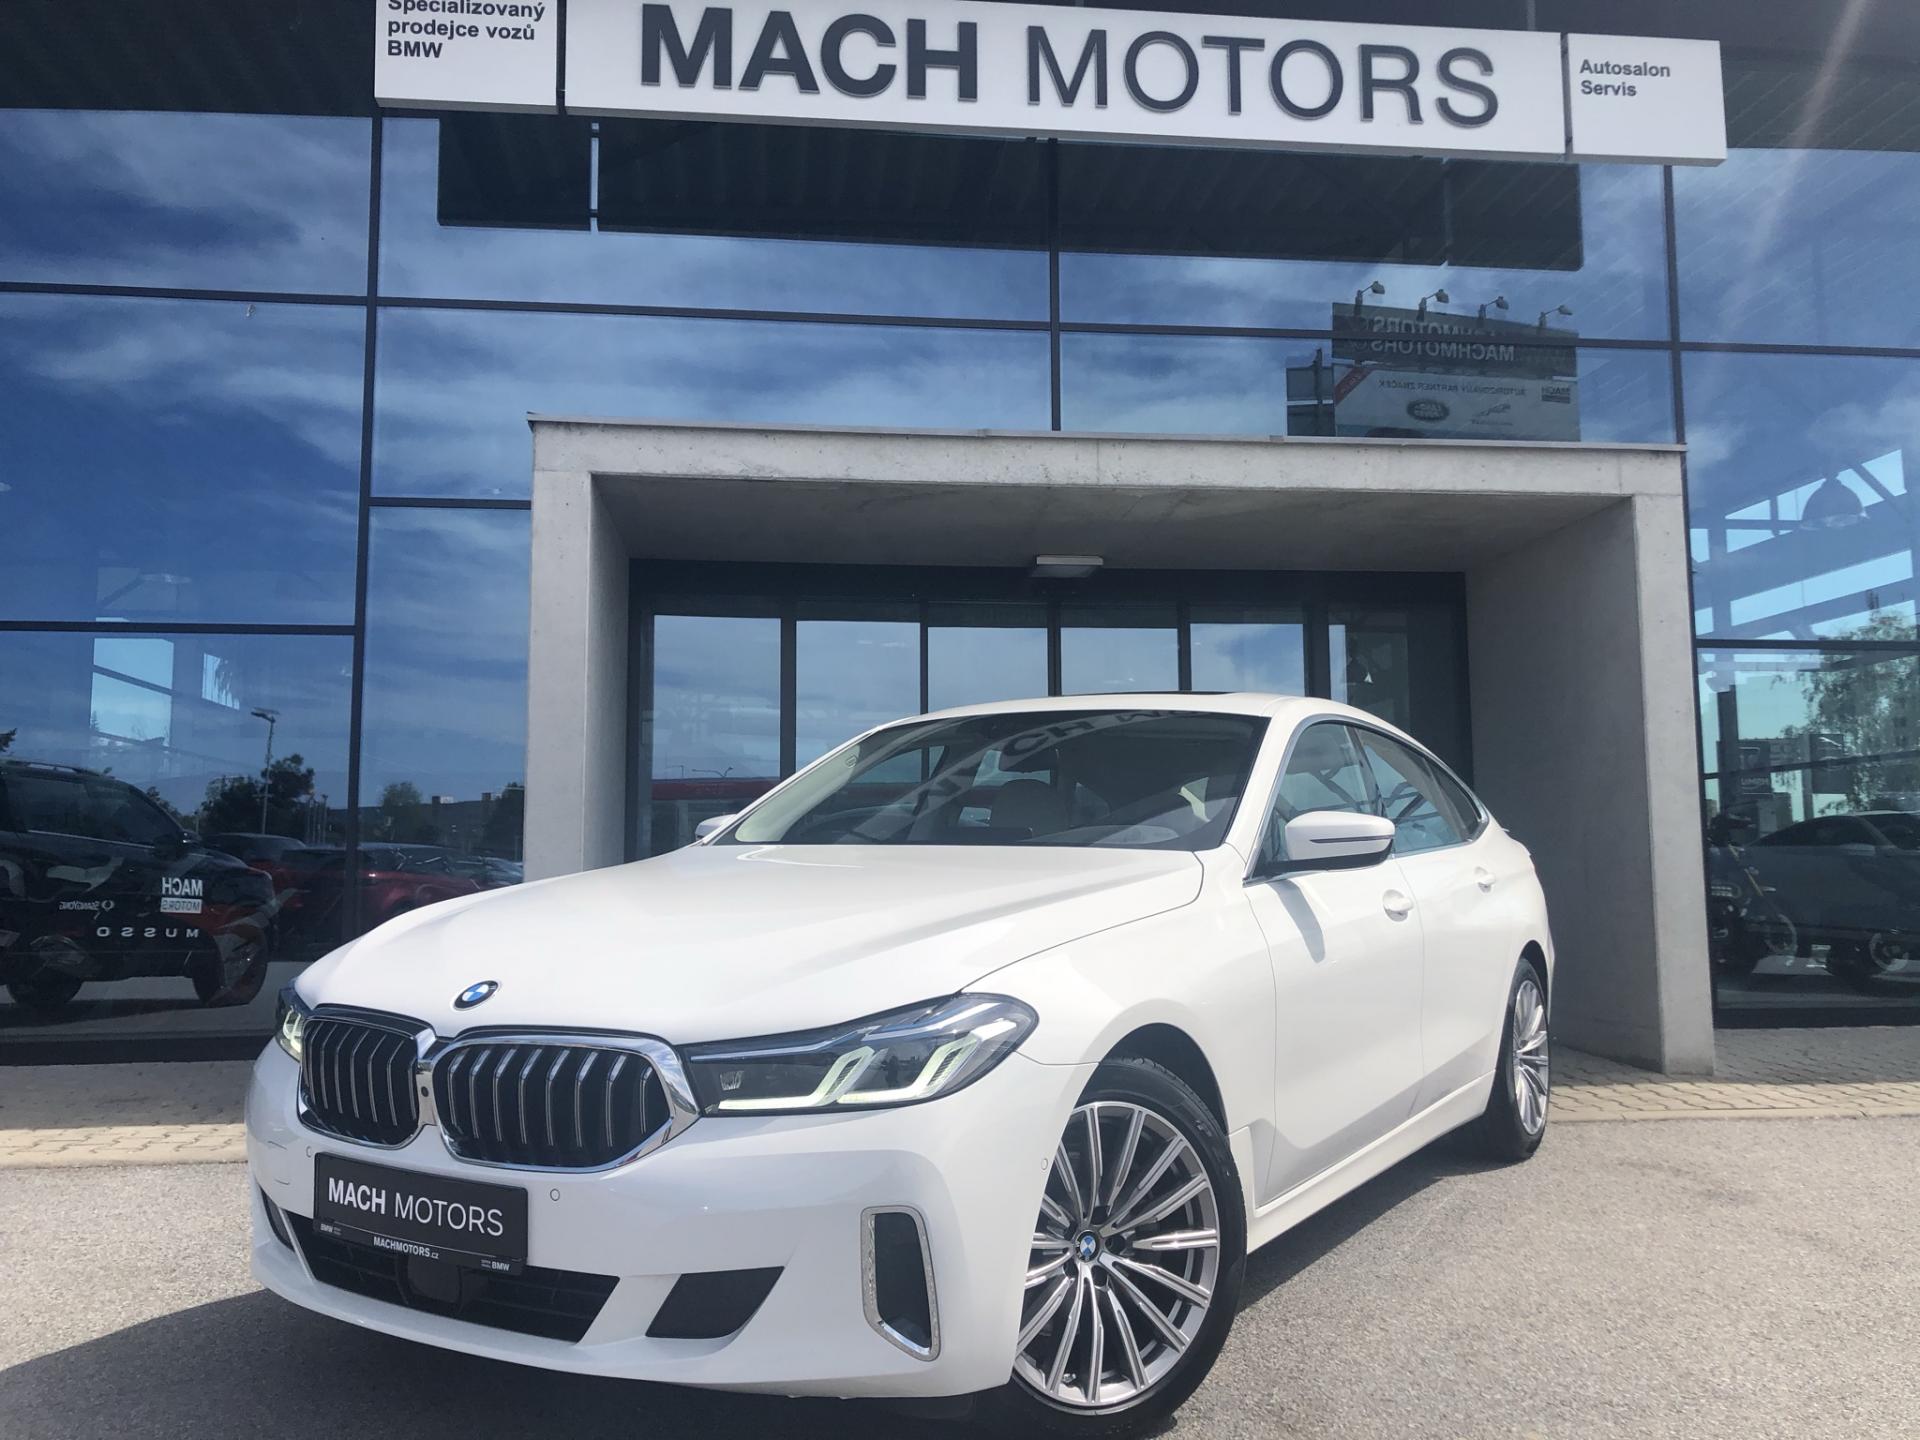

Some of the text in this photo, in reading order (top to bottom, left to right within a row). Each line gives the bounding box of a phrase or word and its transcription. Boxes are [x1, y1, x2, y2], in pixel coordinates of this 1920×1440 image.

[388, 0, 546, 22] Specializovaný
[388, 19, 535, 41] prodejce vozů
[388, 39, 443, 59] BMW
[641, 3, 1499, 129] MACH MOTORS
[1580, 59, 1671, 78] Autosalon
[1580, 79, 1638, 97] Servis
[328, 1177, 504, 1237] MACH MOTORS
[373, 1236, 440, 1260] MACHMOTORS.cz
[491, 1261, 510, 1271] BMW
